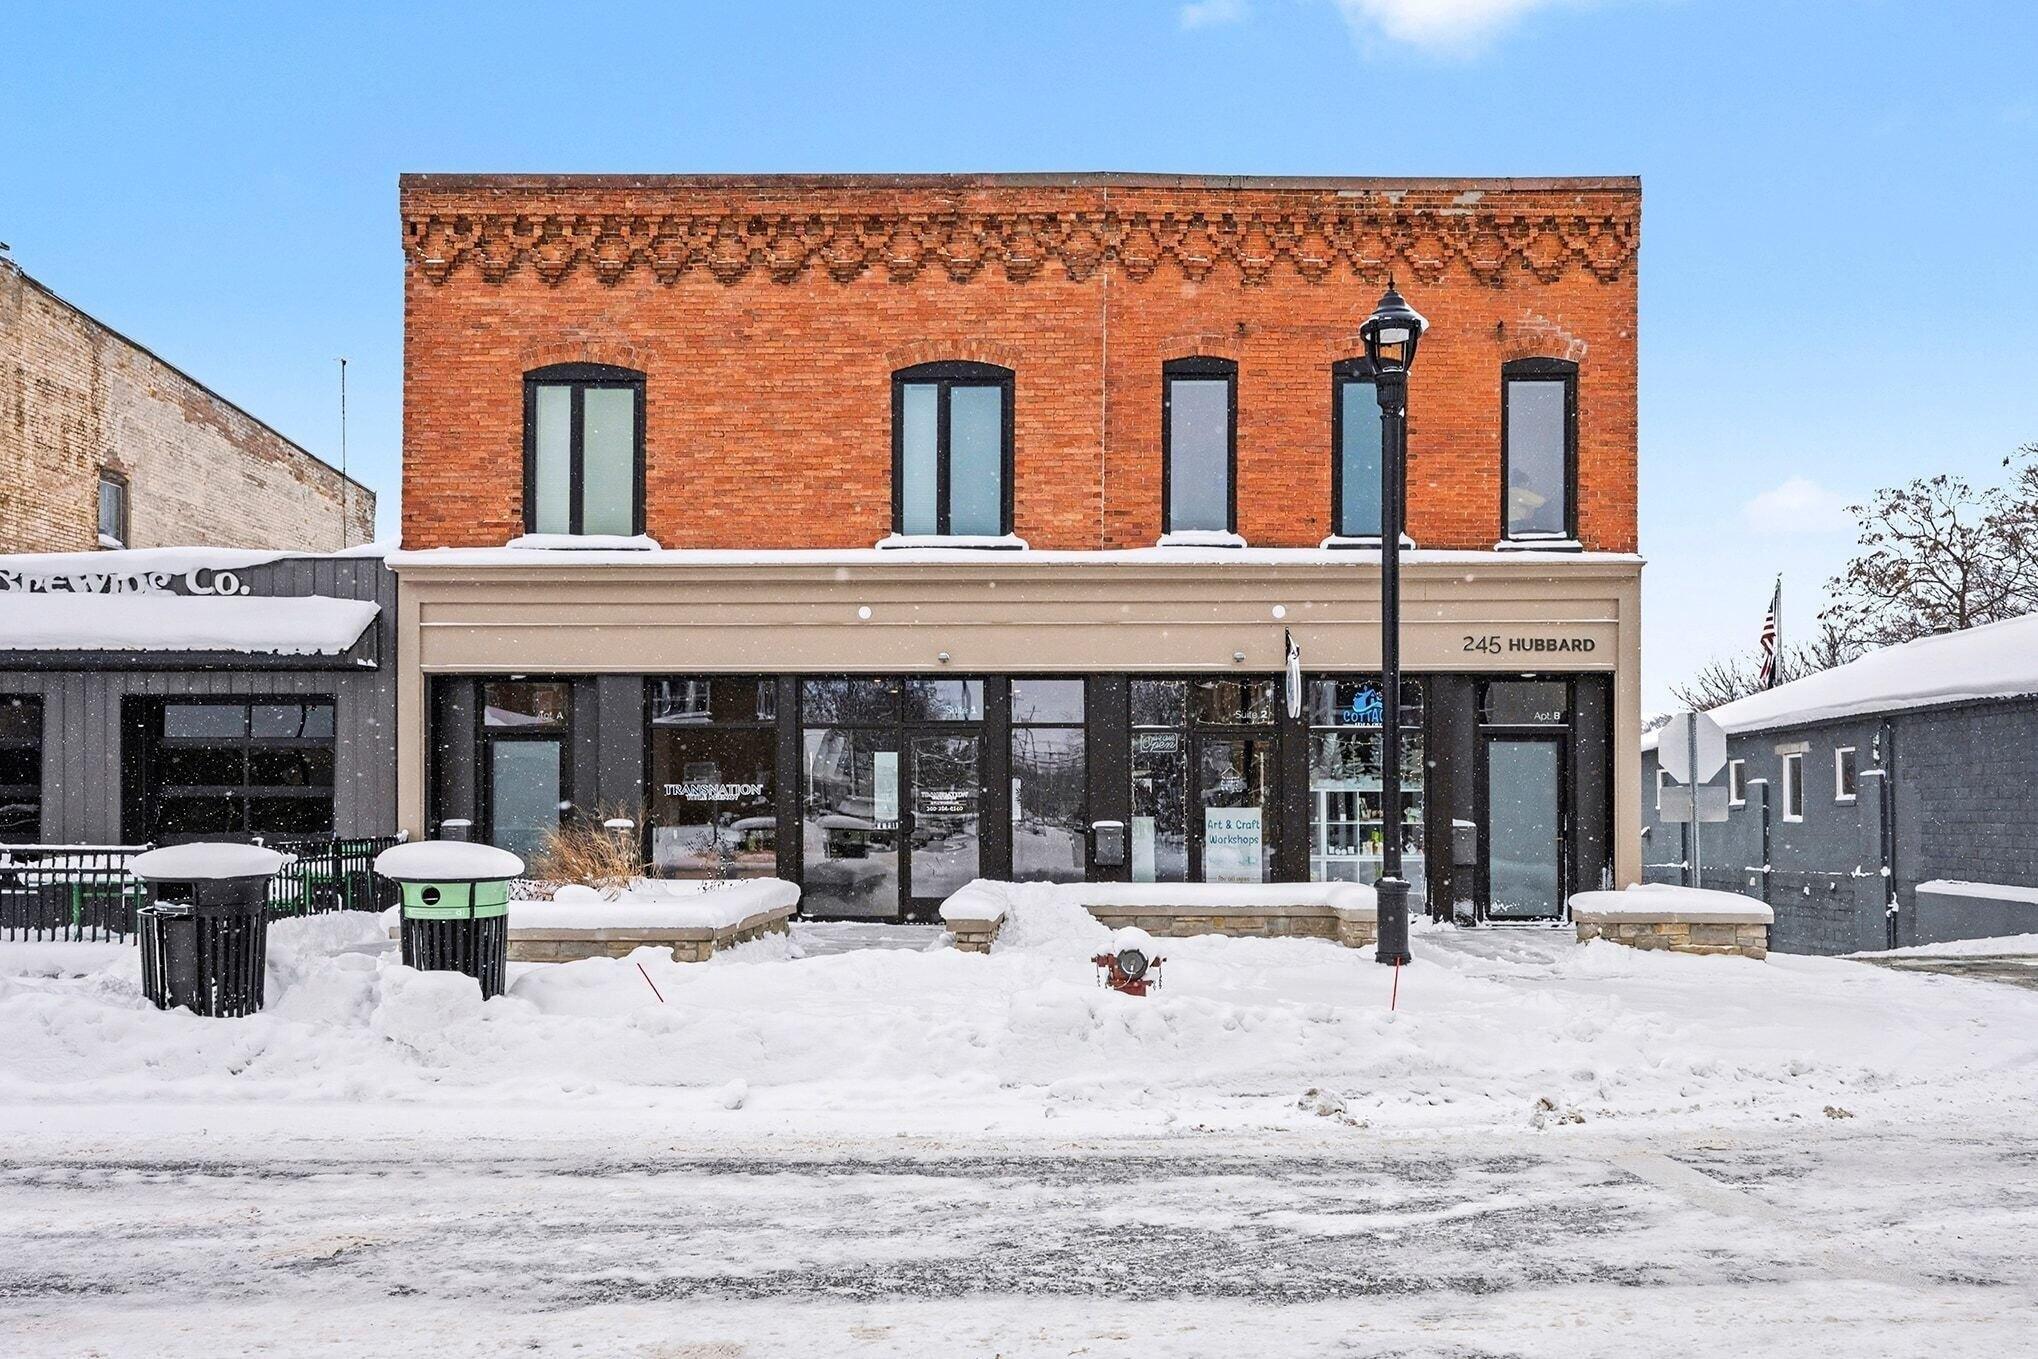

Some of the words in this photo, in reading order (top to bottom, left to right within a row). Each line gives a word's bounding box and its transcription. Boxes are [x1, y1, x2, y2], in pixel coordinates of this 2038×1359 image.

[186, 567, 250, 595] Co.
[1463, 636, 1501, 654] 245
[1509, 638, 1595, 651] HUBBARD
[556, 711, 564, 720] A
[970, 706, 977, 714] 1
[1235, 710, 1258, 719] Suite
[1260, 710, 1268, 719] 2
[1553, 711, 1561, 720] B
[664, 784, 763, 795] TRANSNATION
[1207, 819, 1223, 830] Art
[1225, 820, 1233, 830] &
[1235, 819, 1261, 830] Craft
[1209, 834, 1259, 846] Workshops
